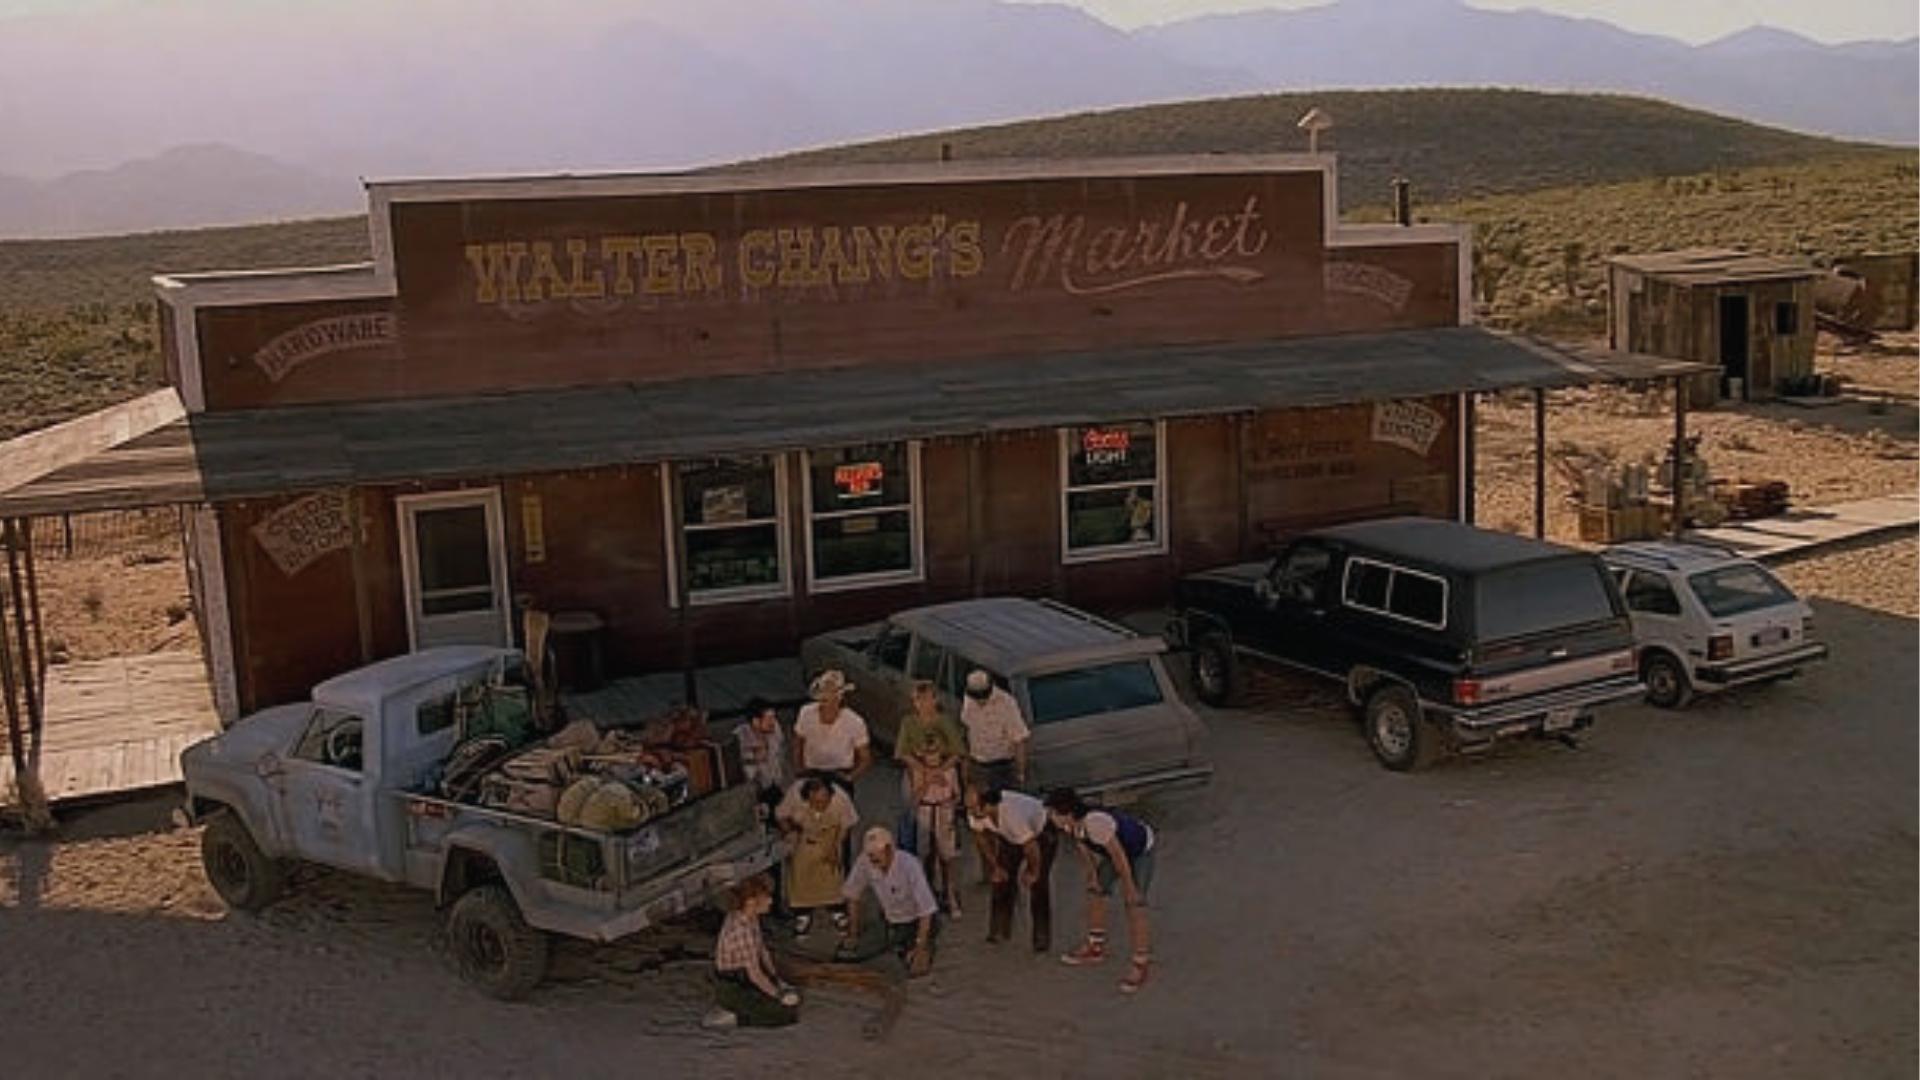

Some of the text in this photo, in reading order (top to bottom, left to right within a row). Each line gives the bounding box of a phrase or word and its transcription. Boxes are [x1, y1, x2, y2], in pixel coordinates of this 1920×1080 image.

[465, 230, 721, 304] WALTER
[737, 213, 984, 288] CHANG'S
[1000, 194, 1269, 295] Market
[259, 316, 387, 374] HARDWARE
